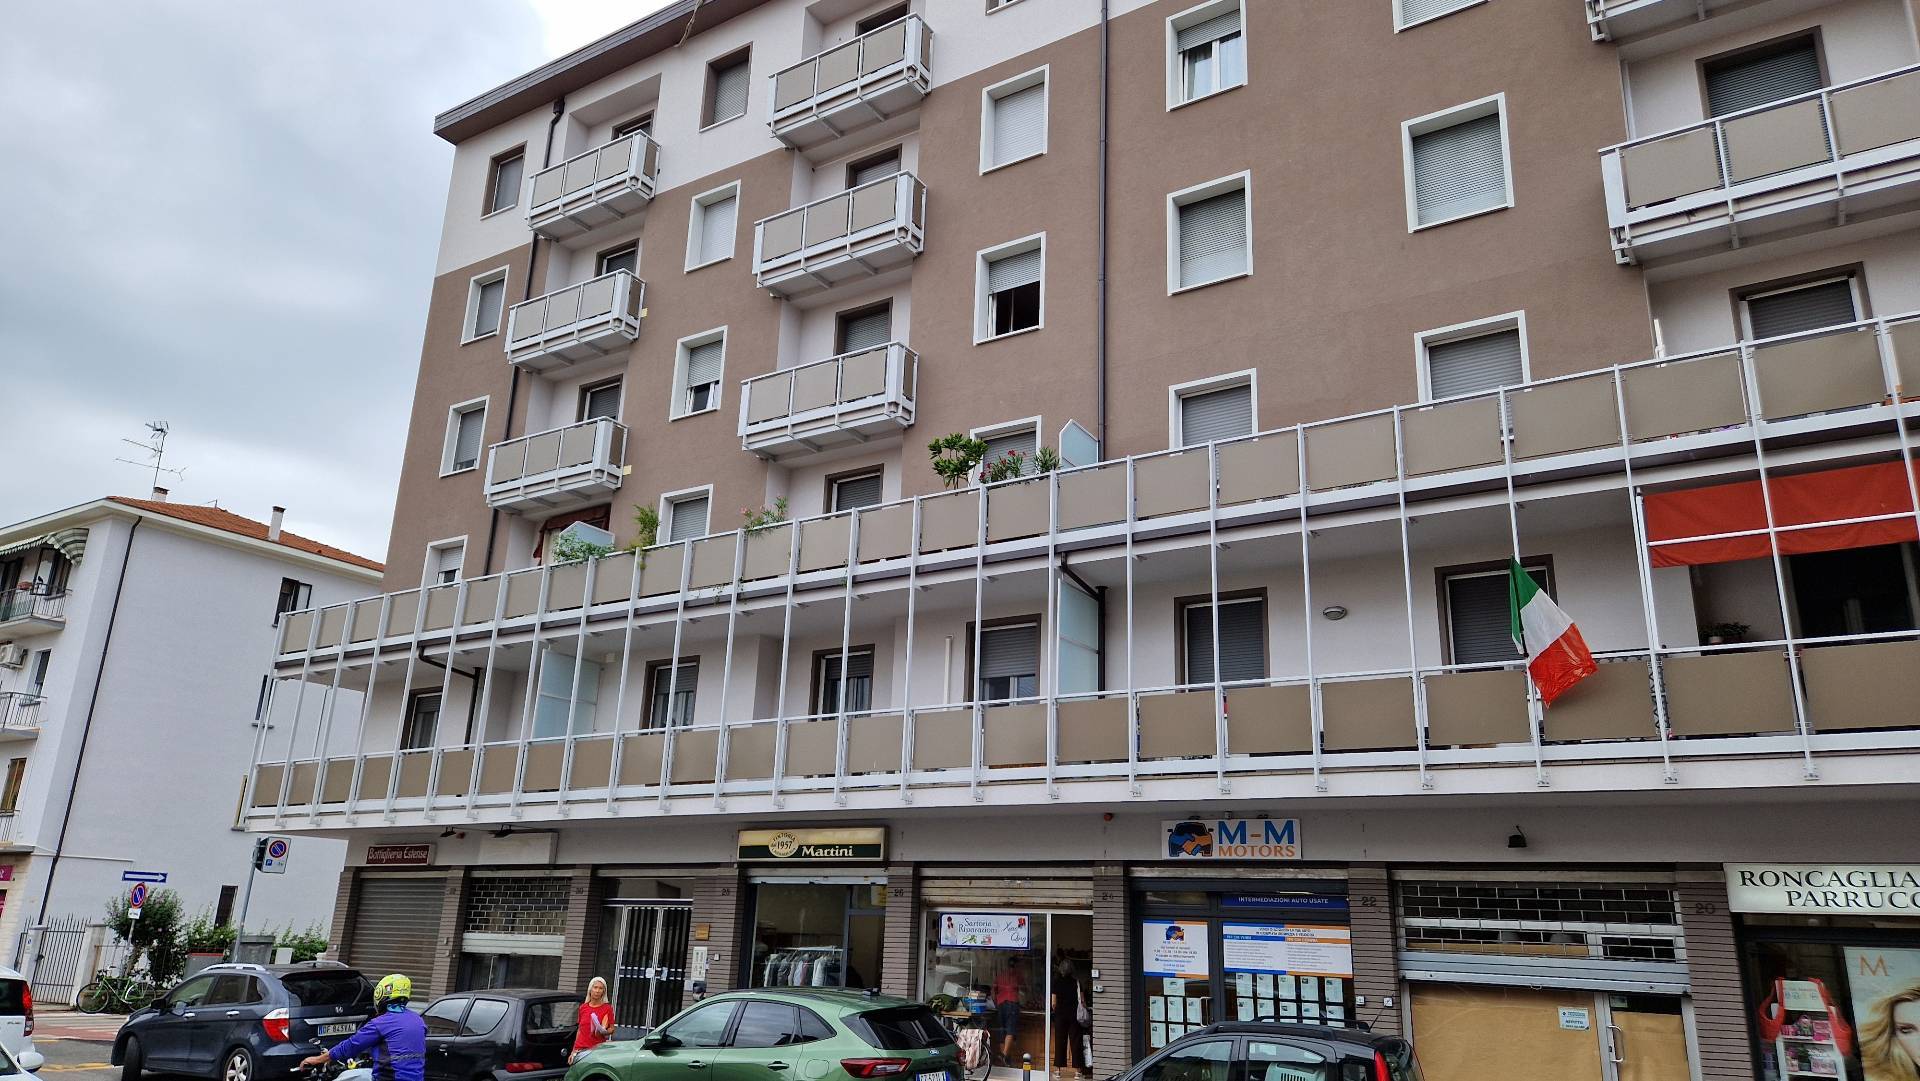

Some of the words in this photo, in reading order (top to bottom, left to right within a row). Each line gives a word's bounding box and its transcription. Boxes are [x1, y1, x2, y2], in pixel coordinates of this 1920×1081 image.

[1217, 820, 1295, 845] M-M
[777, 840, 793, 850] 1957
[801, 845, 854, 857] Martini
[1217, 844, 1296, 858] MOTORS
[368, 847, 403, 863] Bottiglieria
[403, 846, 428, 859] Estense
[1737, 870, 1920, 888] RONCAGLIA
[1238, 896, 1291, 904] INTERMEDIAZIONI
[1361, 896, 1377, 906] 22
[1695, 902, 1716, 914] 20
[964, 917, 992, 928] Sartoria
[1858, 954, 1889, 977] M
